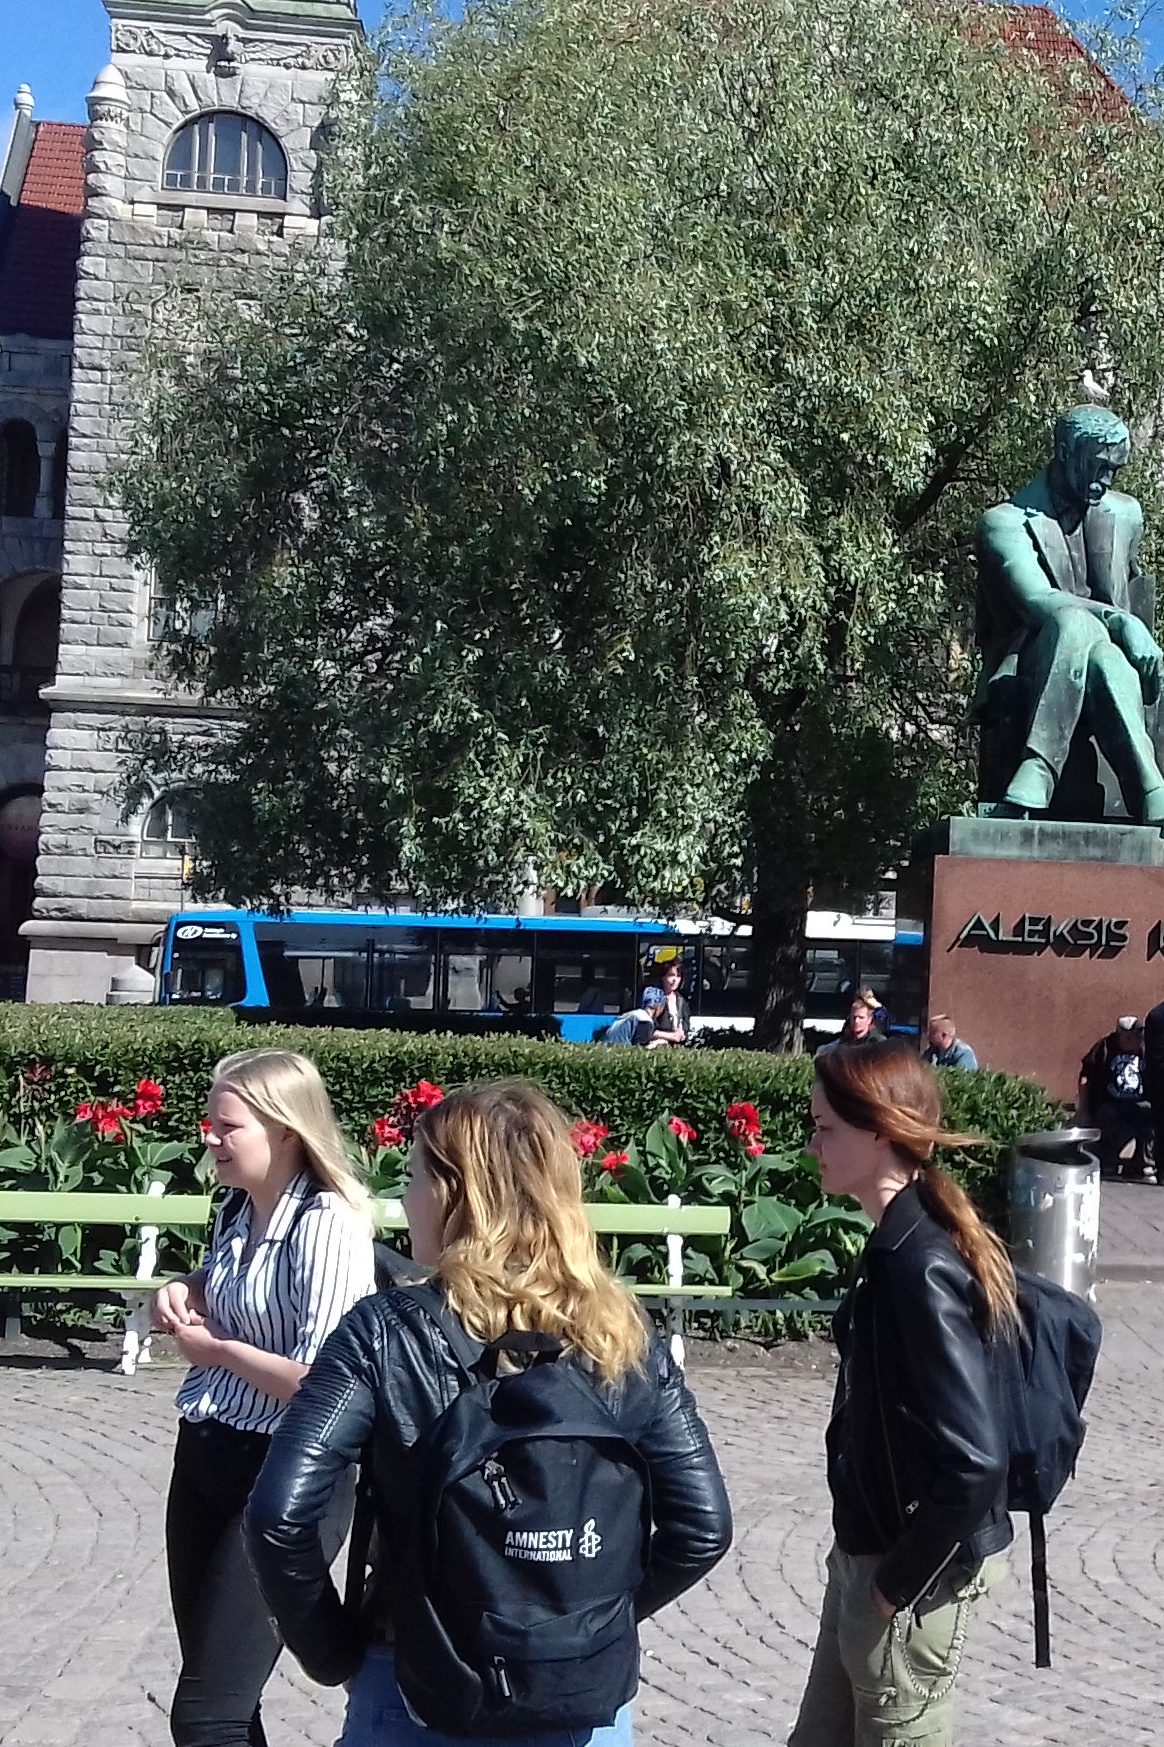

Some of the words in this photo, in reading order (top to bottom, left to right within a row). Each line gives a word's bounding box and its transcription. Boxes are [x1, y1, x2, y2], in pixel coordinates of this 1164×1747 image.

[954, 911, 1131, 955] ALEKSIS
[504, 1528, 574, 1550] AMNESTY
[504, 1547, 573, 1562] INTERNATIONAL
